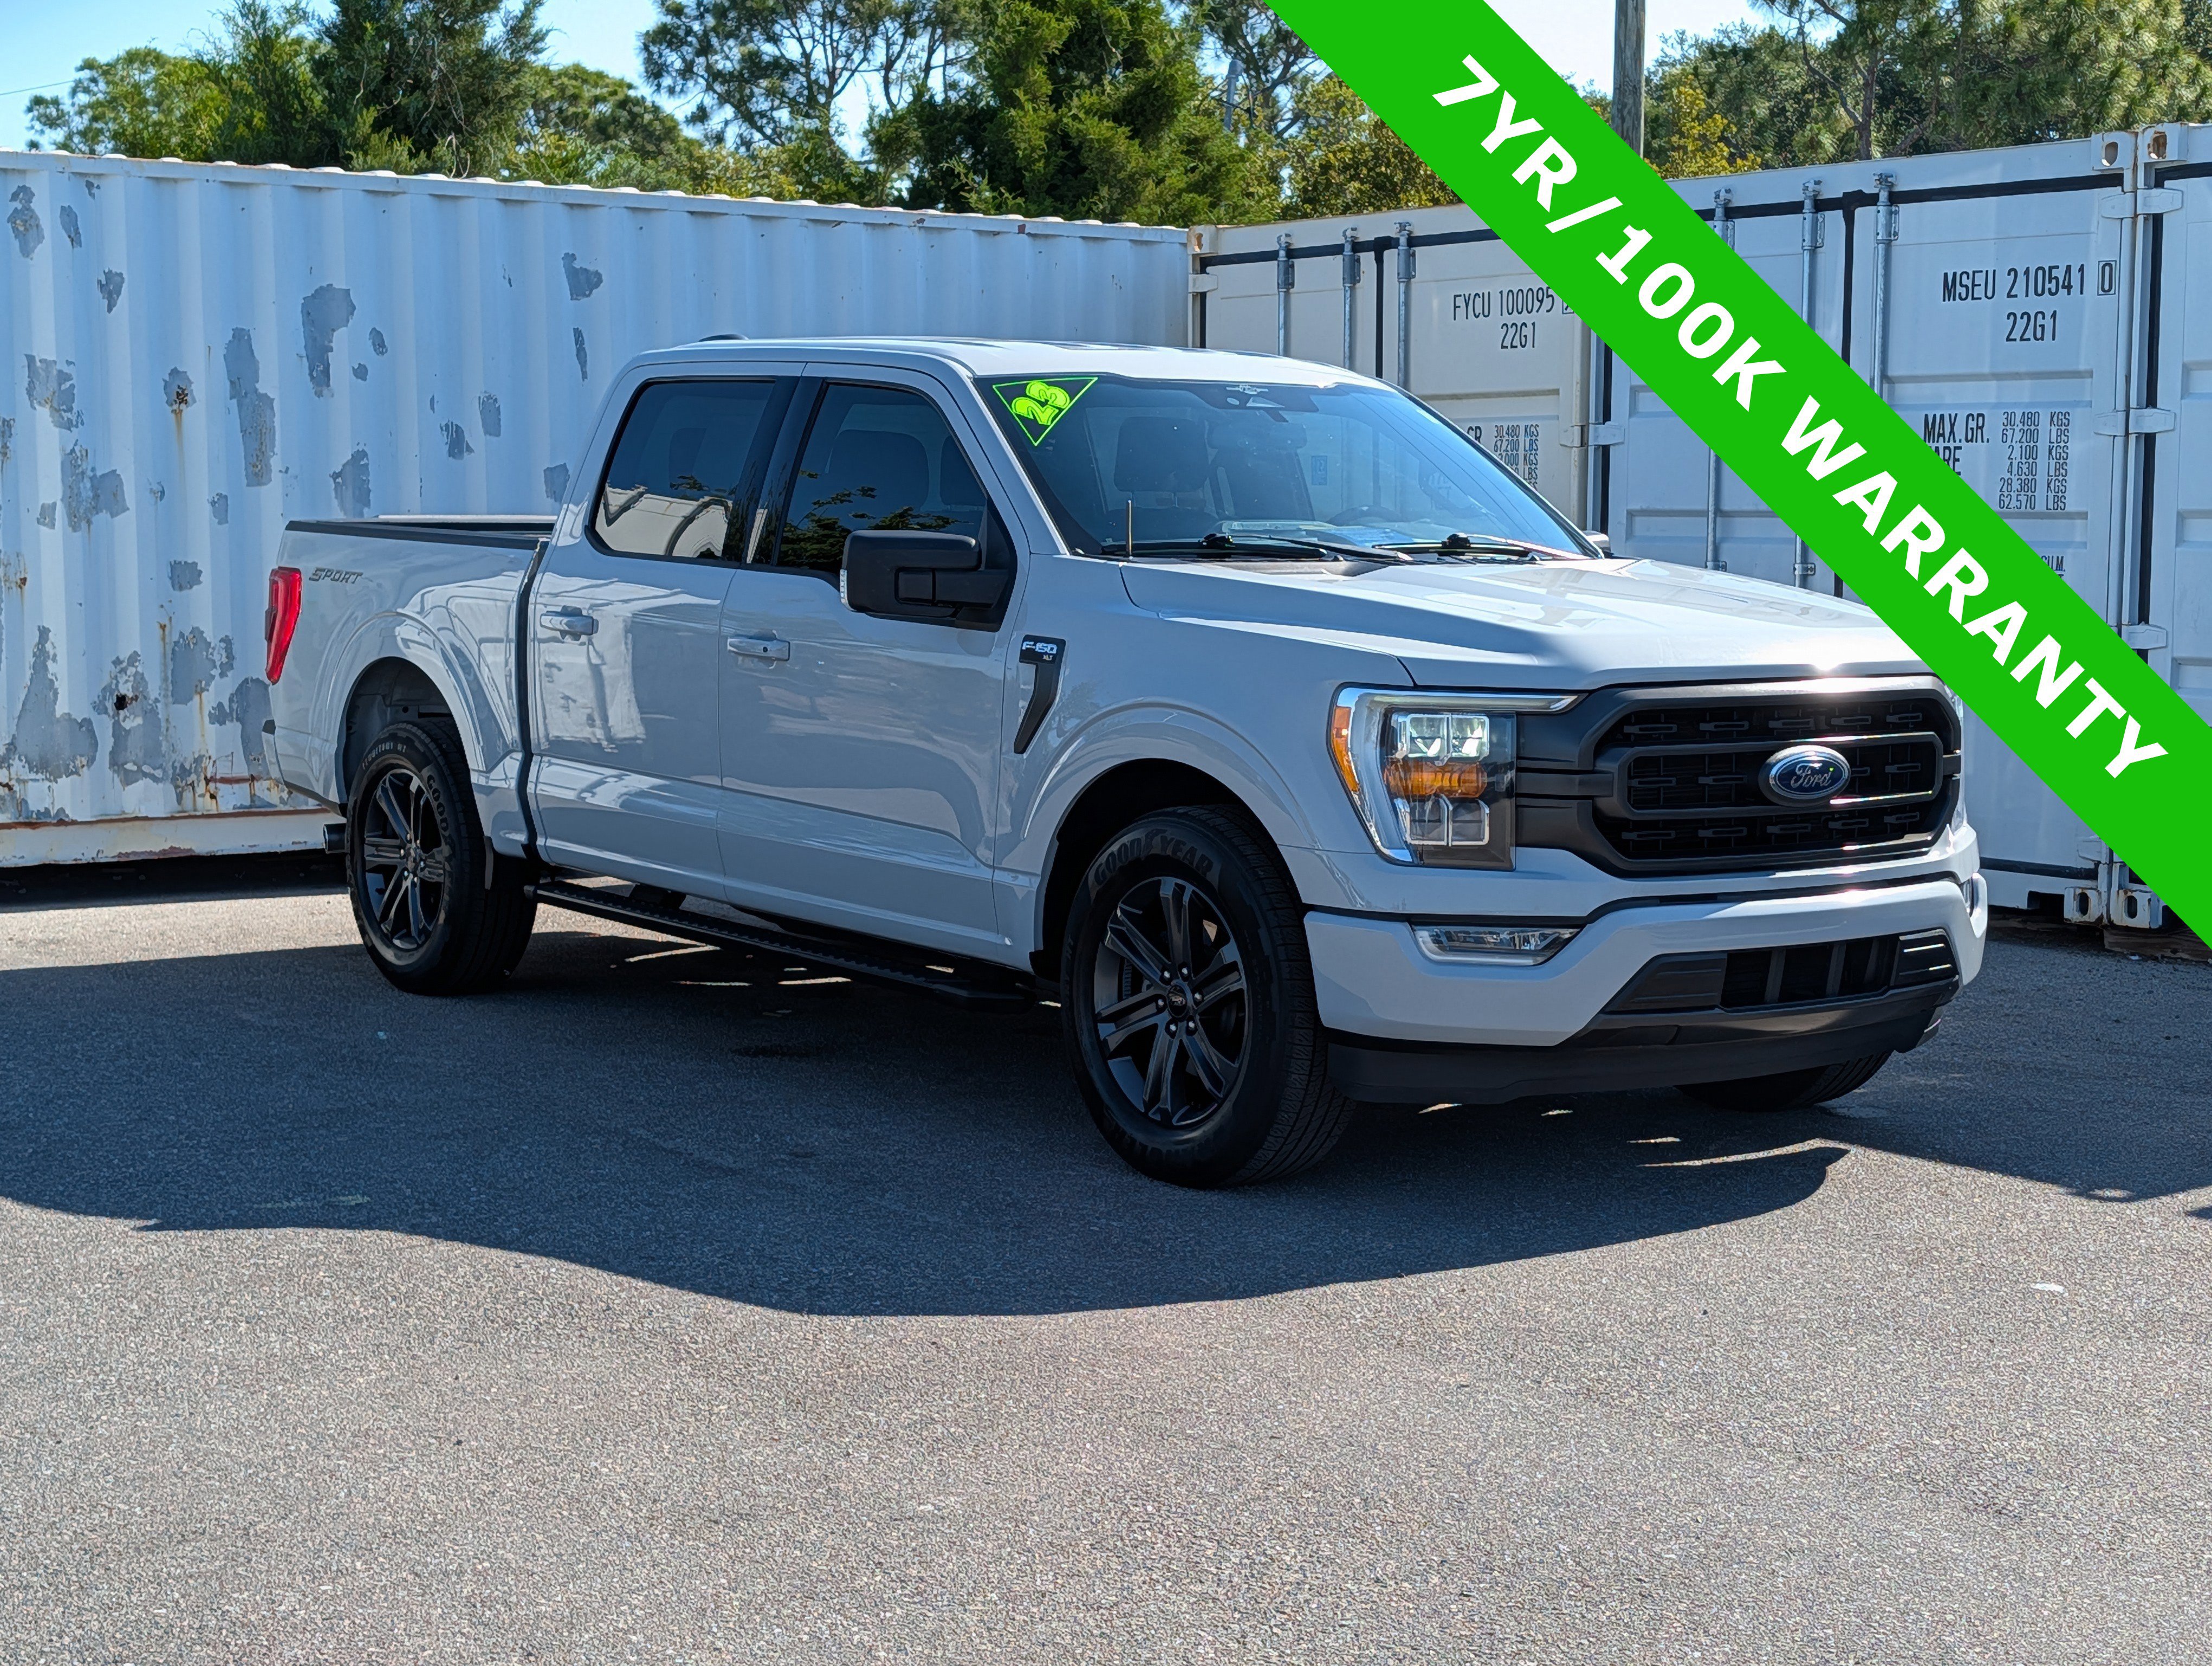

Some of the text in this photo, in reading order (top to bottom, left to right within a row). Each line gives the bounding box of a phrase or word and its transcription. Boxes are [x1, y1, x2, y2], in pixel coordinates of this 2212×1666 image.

[1942, 270, 1996, 302] MSEU
[2006, 264, 2085, 299] 210541
[1453, 287, 1555, 321] FYCU 100095
[2005, 310, 2057, 342] 22G1
[1500, 322, 1536, 349] 22G1
[2049, 411, 2070, 427] KGS
[1524, 424, 1539, 438] KGS
[2048, 428, 2070, 444] LBS
[1523, 438, 1539, 452] LBS
[2048, 445, 2069, 461] KGS
[1523, 452, 1538, 466] KGS
[2047, 462, 2068, 477] LBS
[2046, 478, 2067, 494] KGS
[2046, 494, 2066, 511] LBS
[308, 567, 364, 584] SPORT
[1790, 762, 1832, 789] Ford
